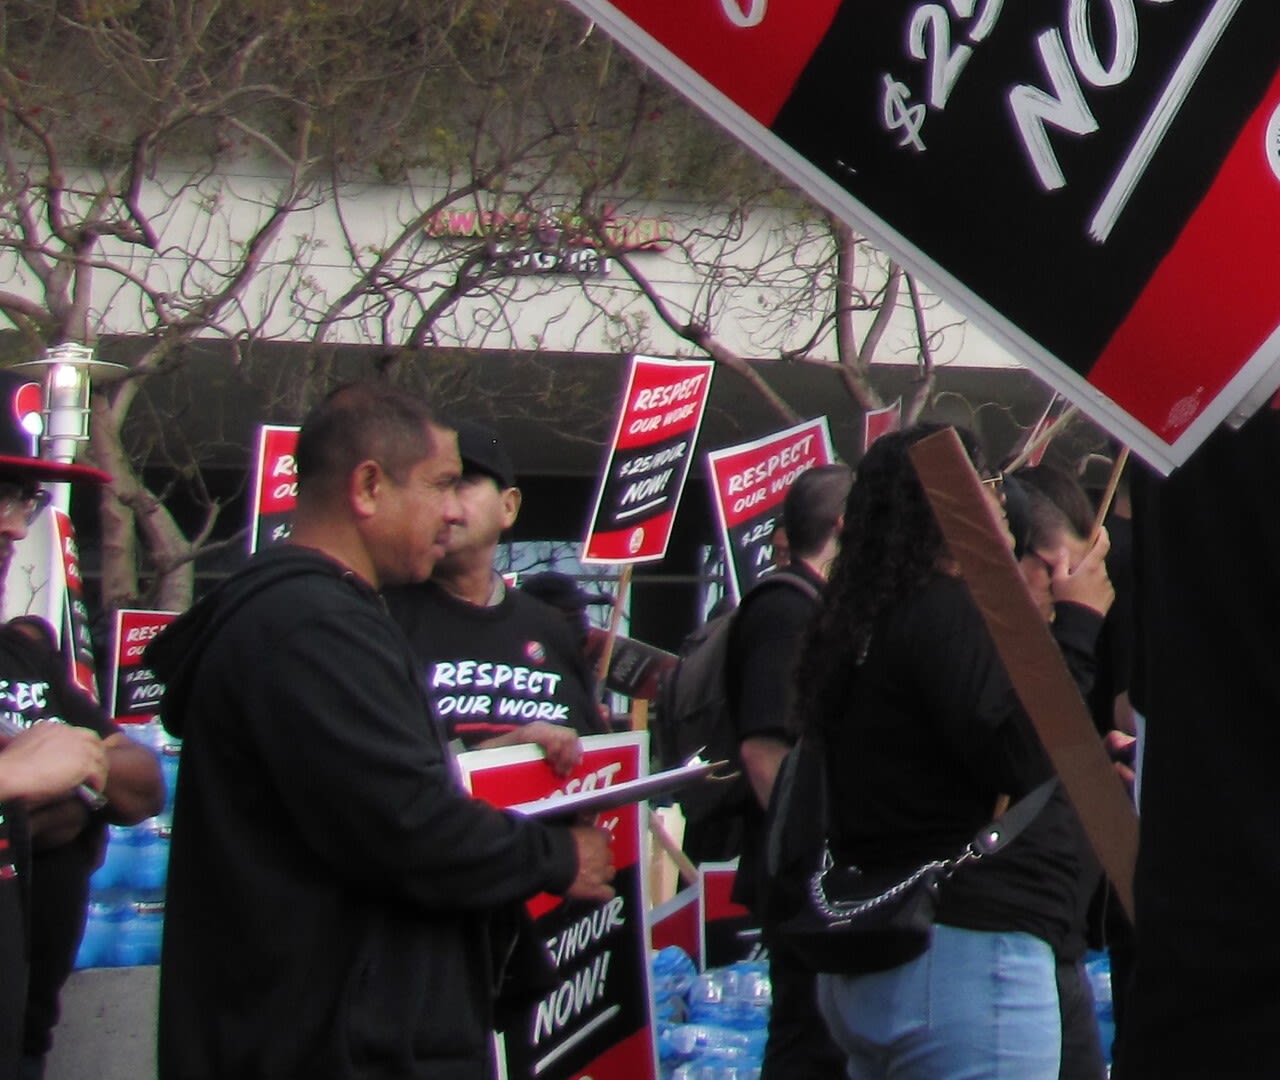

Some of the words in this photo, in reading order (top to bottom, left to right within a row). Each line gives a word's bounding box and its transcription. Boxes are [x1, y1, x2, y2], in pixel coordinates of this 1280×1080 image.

[633, 373, 705, 412] RESPECT
[629, 412, 661, 435] OUR
[662, 401, 698, 427] WORK
[728, 434, 815, 497] RESPECT
[621, 468, 674, 506] NOW!
[733, 488, 766, 514] OUR
[433, 660, 561, 697] RESPECT
[438, 694, 491, 716] OUR
[499, 700, 570, 721] WORK
[532, 951, 612, 1044] NOW!
